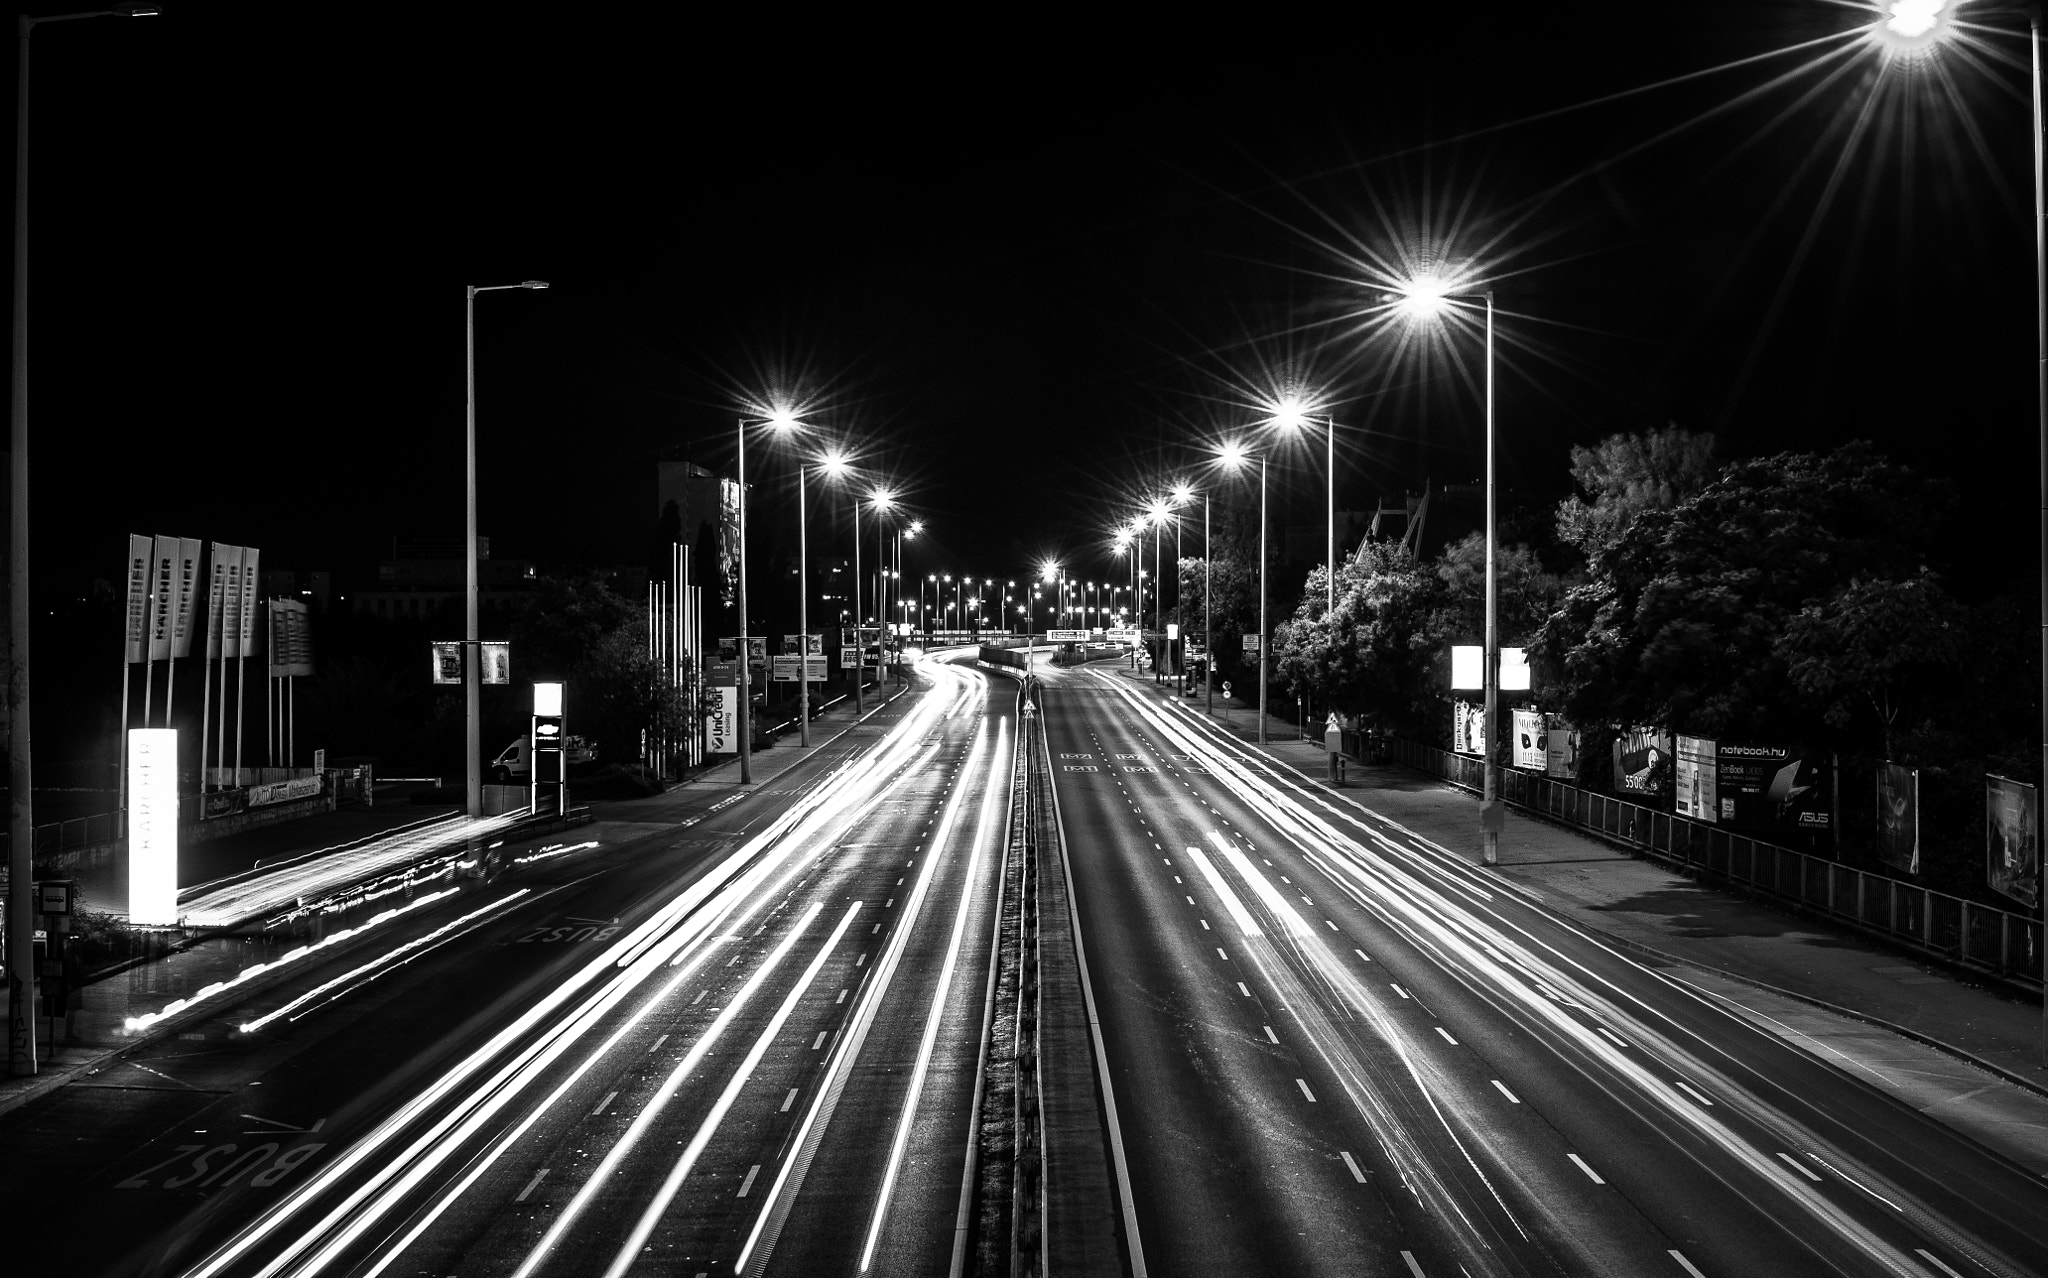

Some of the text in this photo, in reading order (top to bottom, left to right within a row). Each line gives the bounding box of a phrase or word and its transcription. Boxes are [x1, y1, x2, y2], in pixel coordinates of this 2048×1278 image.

[712, 690, 723, 736] UniCredit
[1720, 746, 1785, 757] notebook.hu
[1799, 812, 1829, 823] ASUS
[516, 926, 623, 943] BUSZ
[112, 1142, 328, 1189] BUSZ
